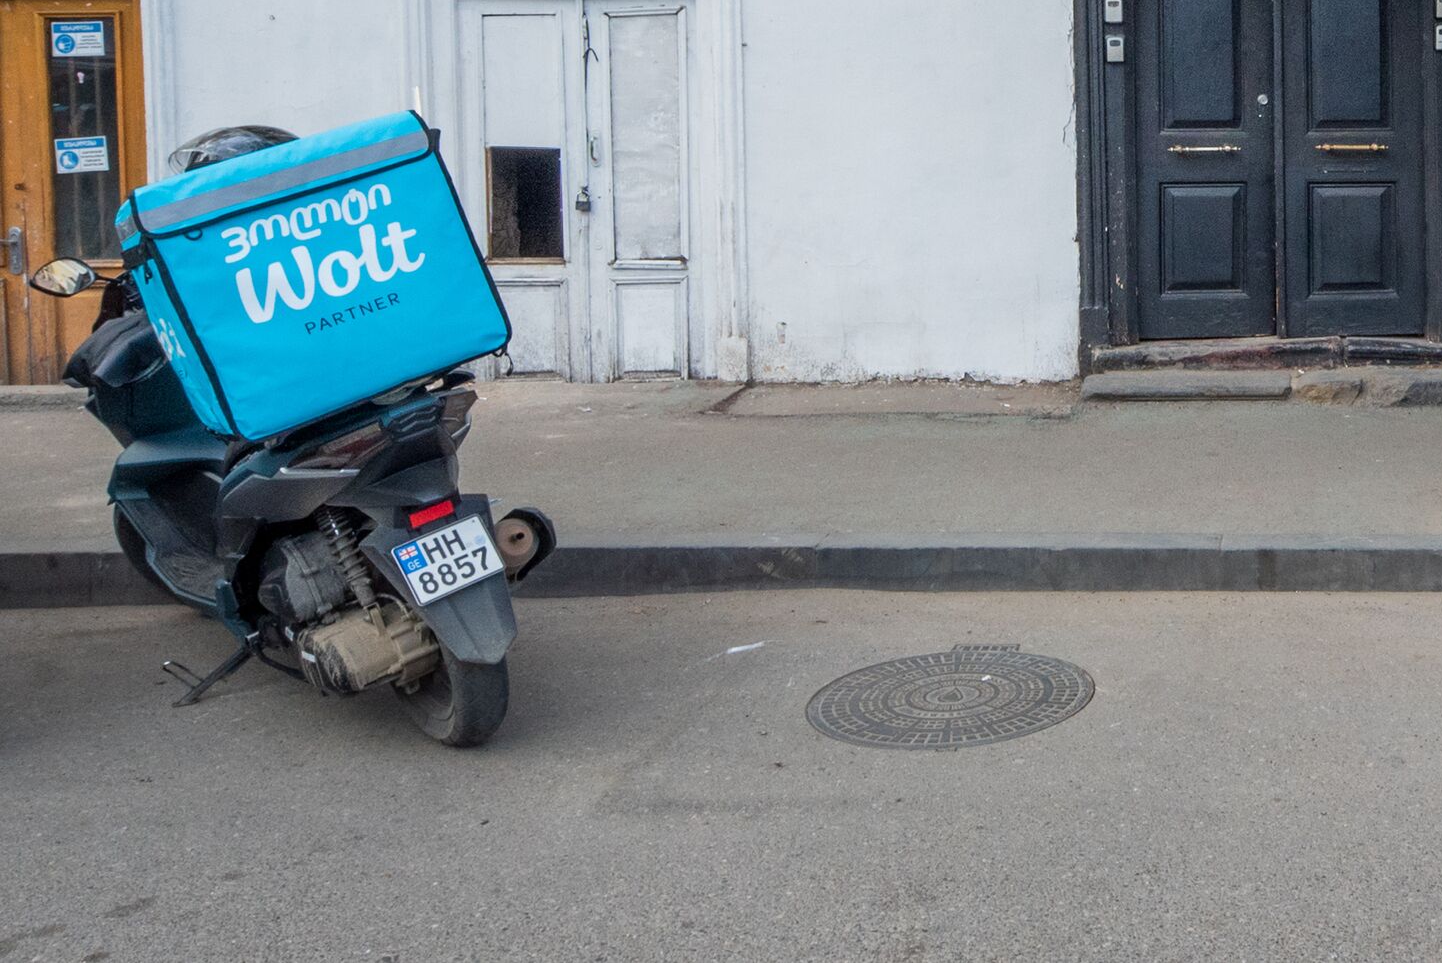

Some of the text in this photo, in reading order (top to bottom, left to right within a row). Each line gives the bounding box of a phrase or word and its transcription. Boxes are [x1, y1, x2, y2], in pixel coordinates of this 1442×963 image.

[235, 222, 426, 324] Wolt
[304, 292, 401, 335] PARTNER
[407, 558, 422, 571] GE
[421, 529, 466, 564] HH
[418, 546, 489, 594] 8857
